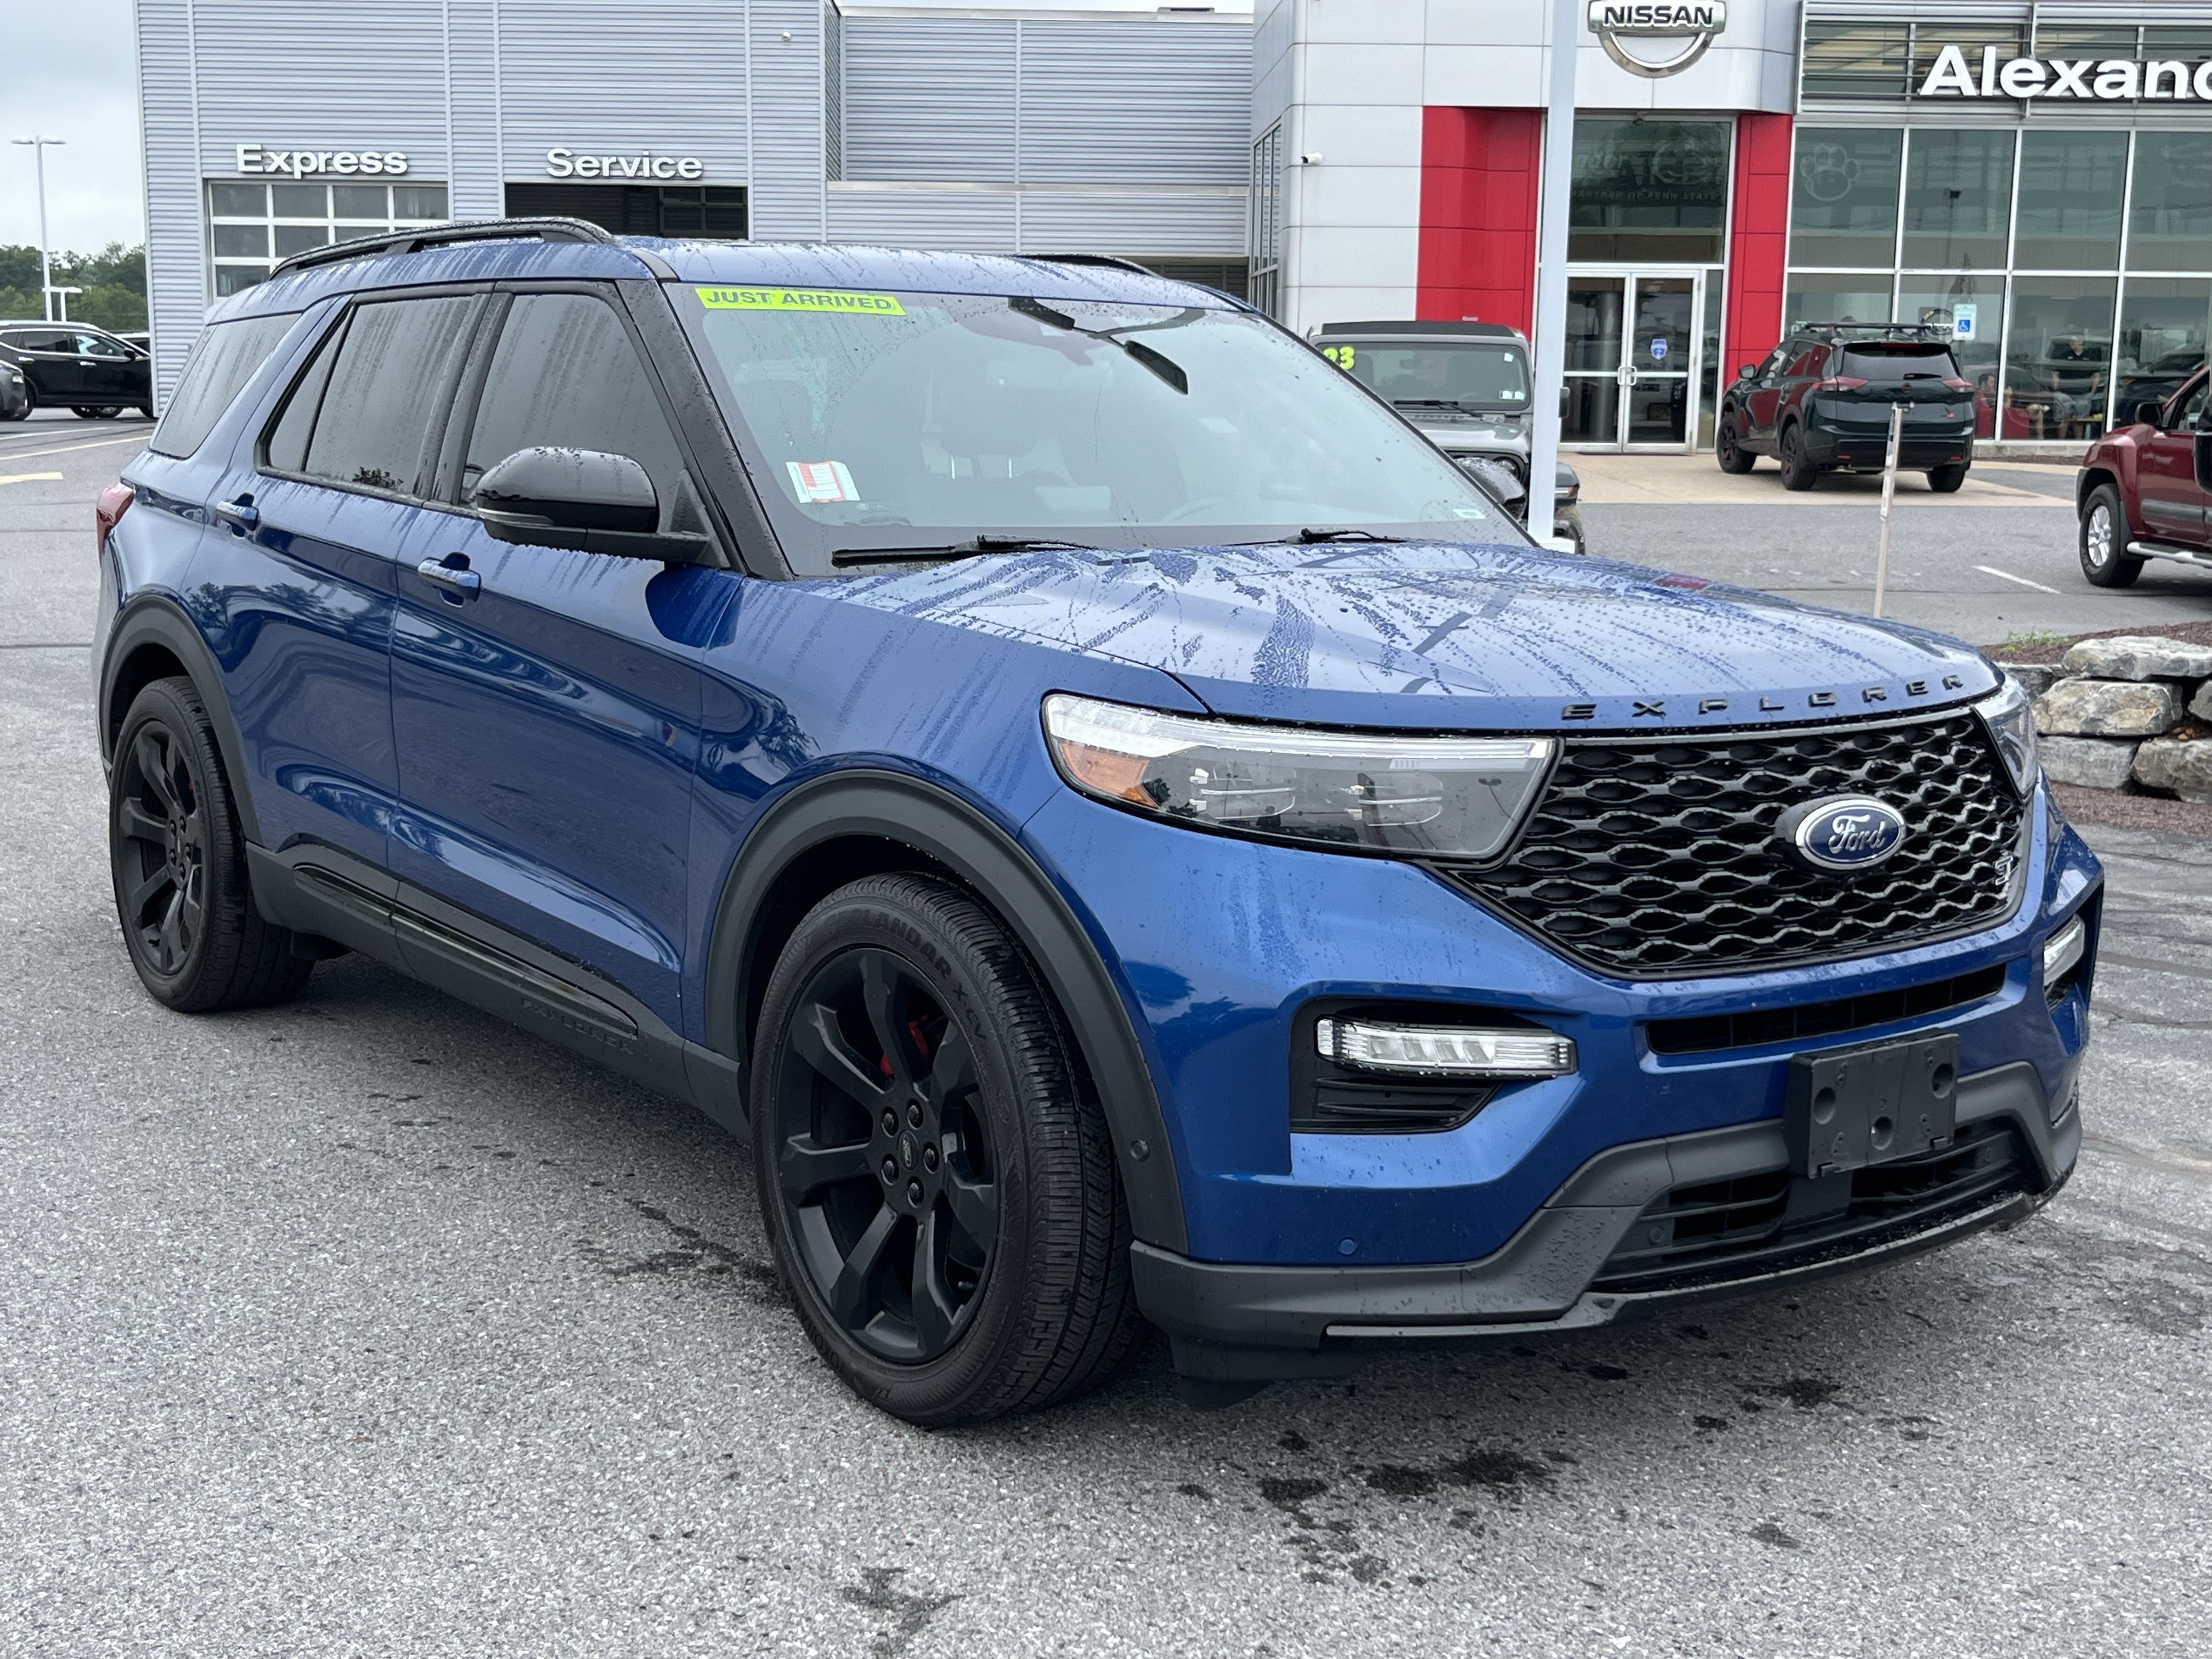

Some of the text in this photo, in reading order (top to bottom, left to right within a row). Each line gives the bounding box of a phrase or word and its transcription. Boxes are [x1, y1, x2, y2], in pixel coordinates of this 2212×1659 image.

[1603, 5, 1714, 27] NISSAN
[236, 144, 409, 180] Express
[546, 148, 703, 179] Service
[707, 291, 895, 310] JUST ARRIVED
[1561, 674, 1964, 720] EXPLORER
[1828, 814, 1886, 854] Ford
